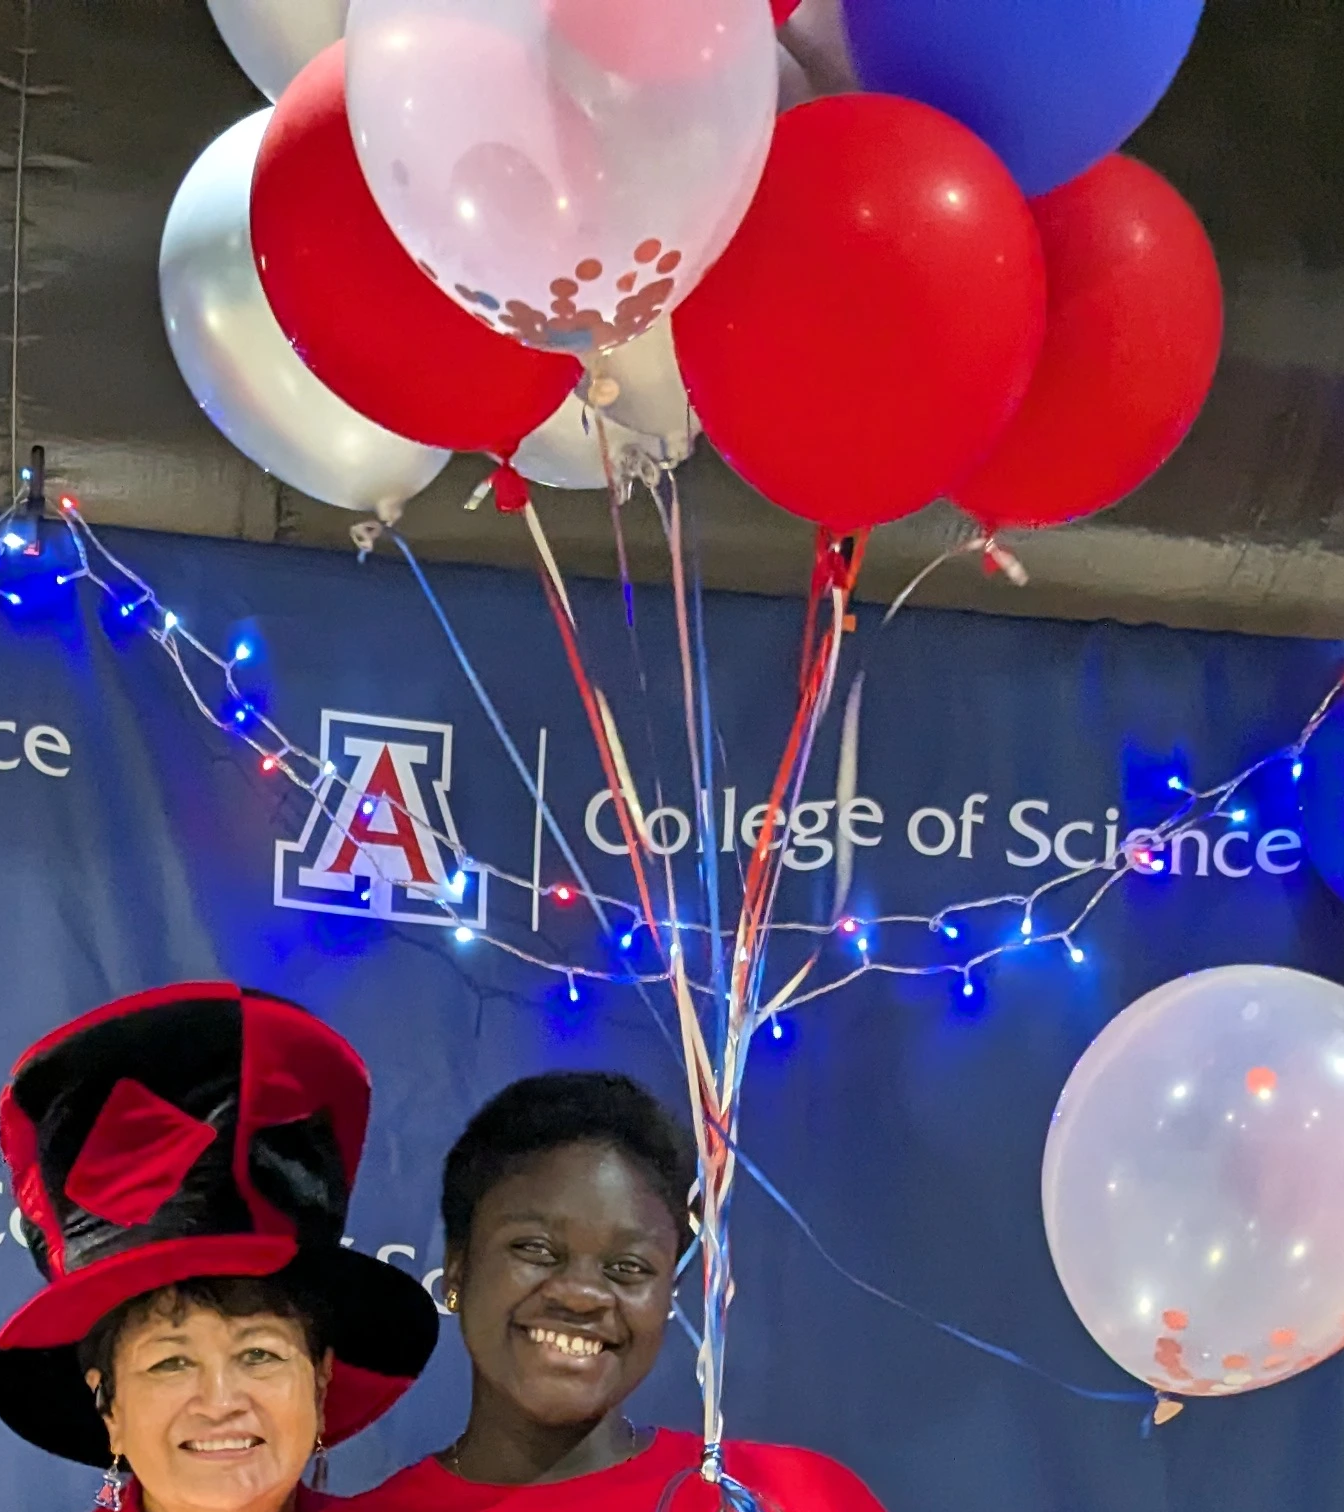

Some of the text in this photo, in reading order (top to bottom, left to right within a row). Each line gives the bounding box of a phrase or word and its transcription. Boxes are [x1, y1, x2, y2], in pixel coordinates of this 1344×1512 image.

[273, 708, 488, 930] A
[907, 792, 989, 859] of
[1005, 799, 1303, 878] Science
